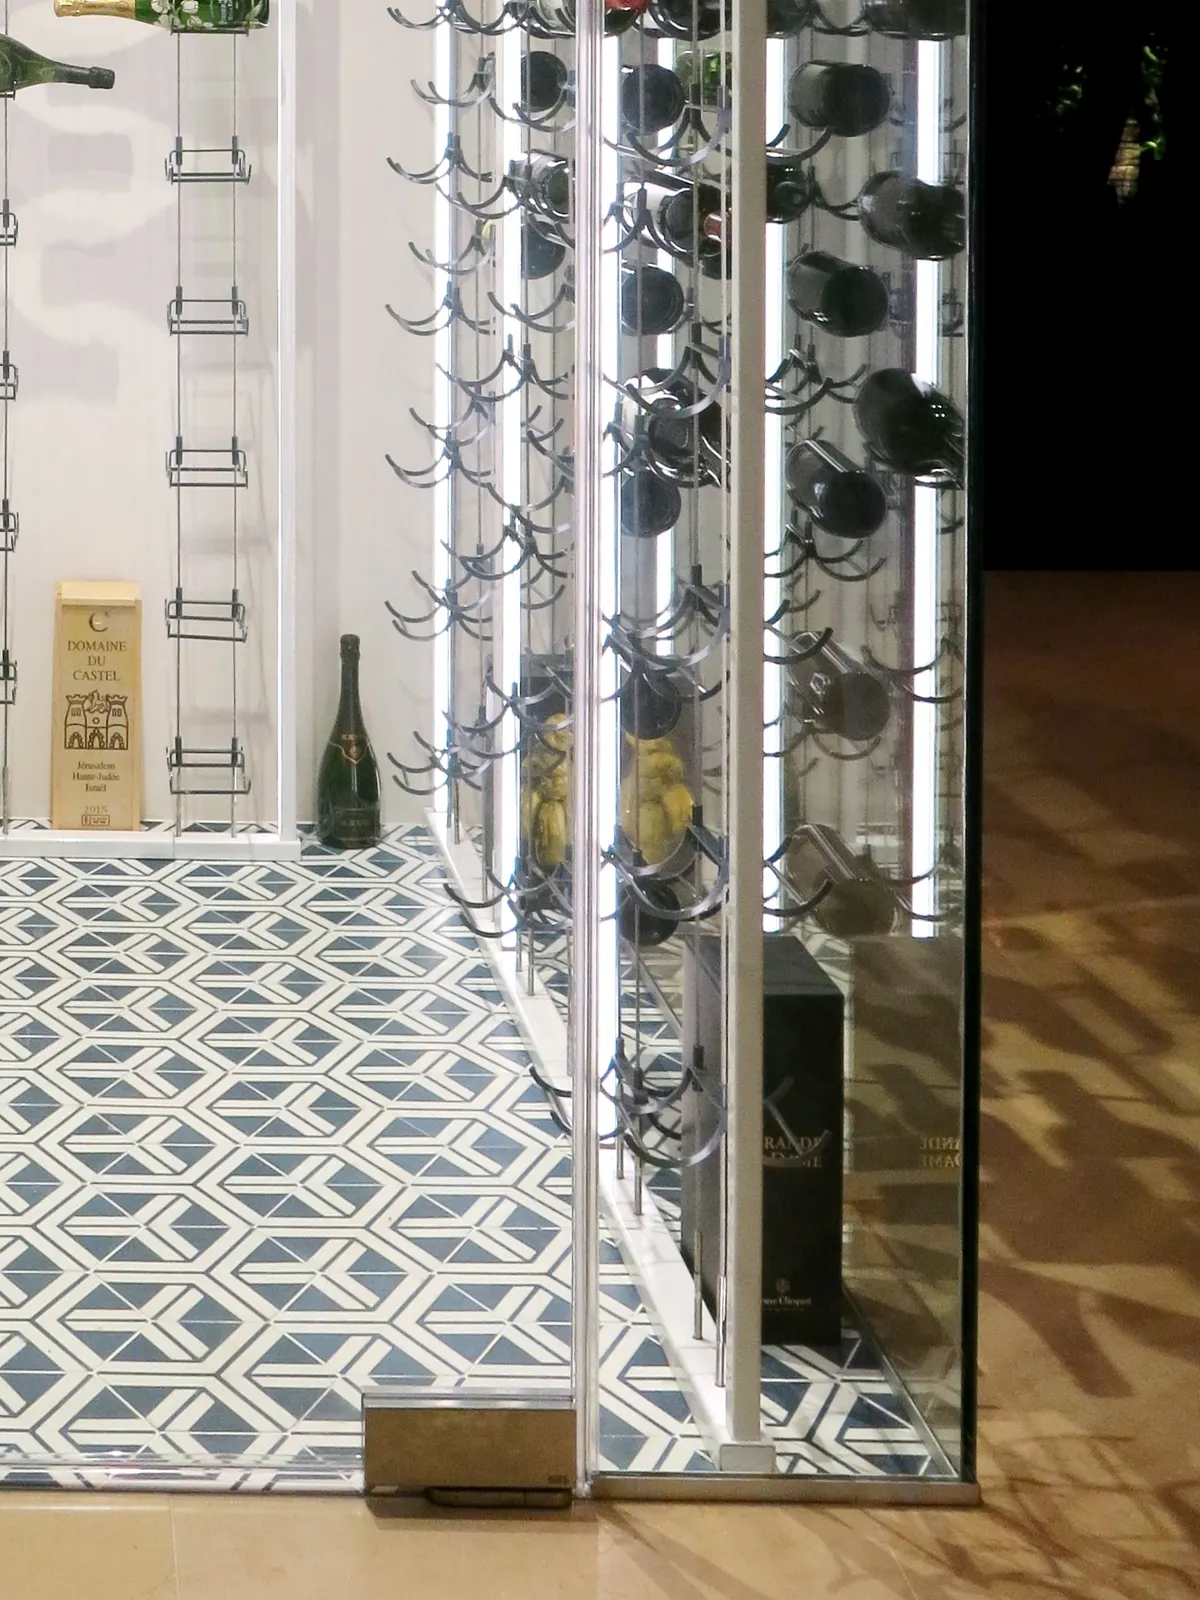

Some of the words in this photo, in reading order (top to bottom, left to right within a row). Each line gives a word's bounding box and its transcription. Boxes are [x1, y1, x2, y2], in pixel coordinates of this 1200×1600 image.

[88, 611, 109, 632] C
[67, 640, 128, 652] DOMAINE
[88, 655, 106, 667] DU
[73, 669, 121, 681] CASTEL
